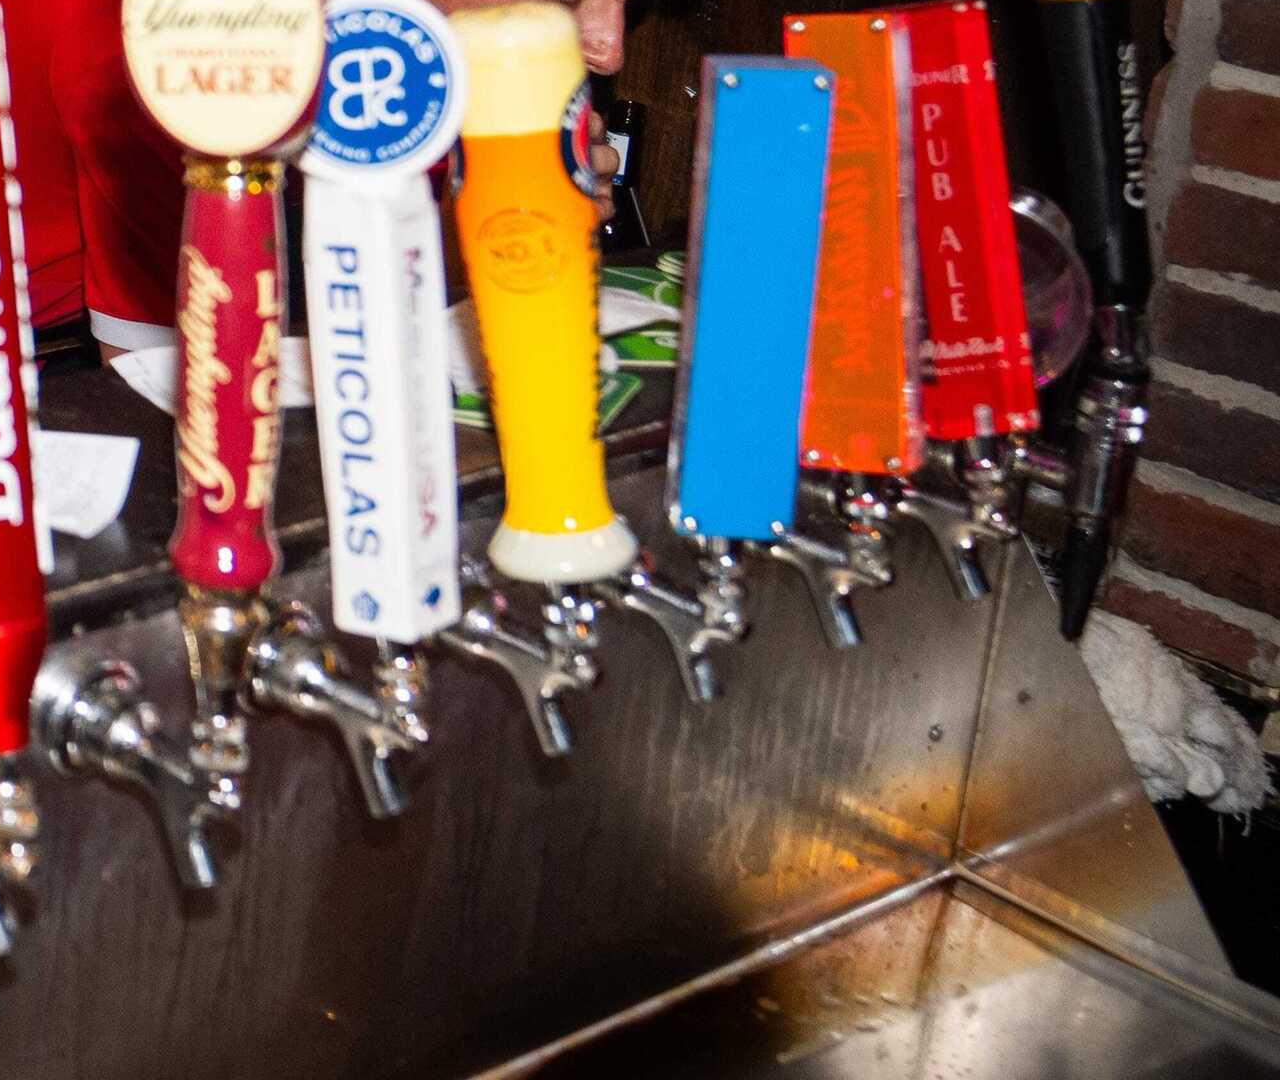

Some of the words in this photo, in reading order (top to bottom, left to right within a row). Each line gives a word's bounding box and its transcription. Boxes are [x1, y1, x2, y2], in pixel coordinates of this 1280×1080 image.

[152, 65, 299, 97] LAGER
[1117, 41, 1147, 209] GUINNESS
[921, 103, 953, 201] PUB
[938, 225, 969, 322] ALE
[324, 243, 381, 558] PETICOLAS
